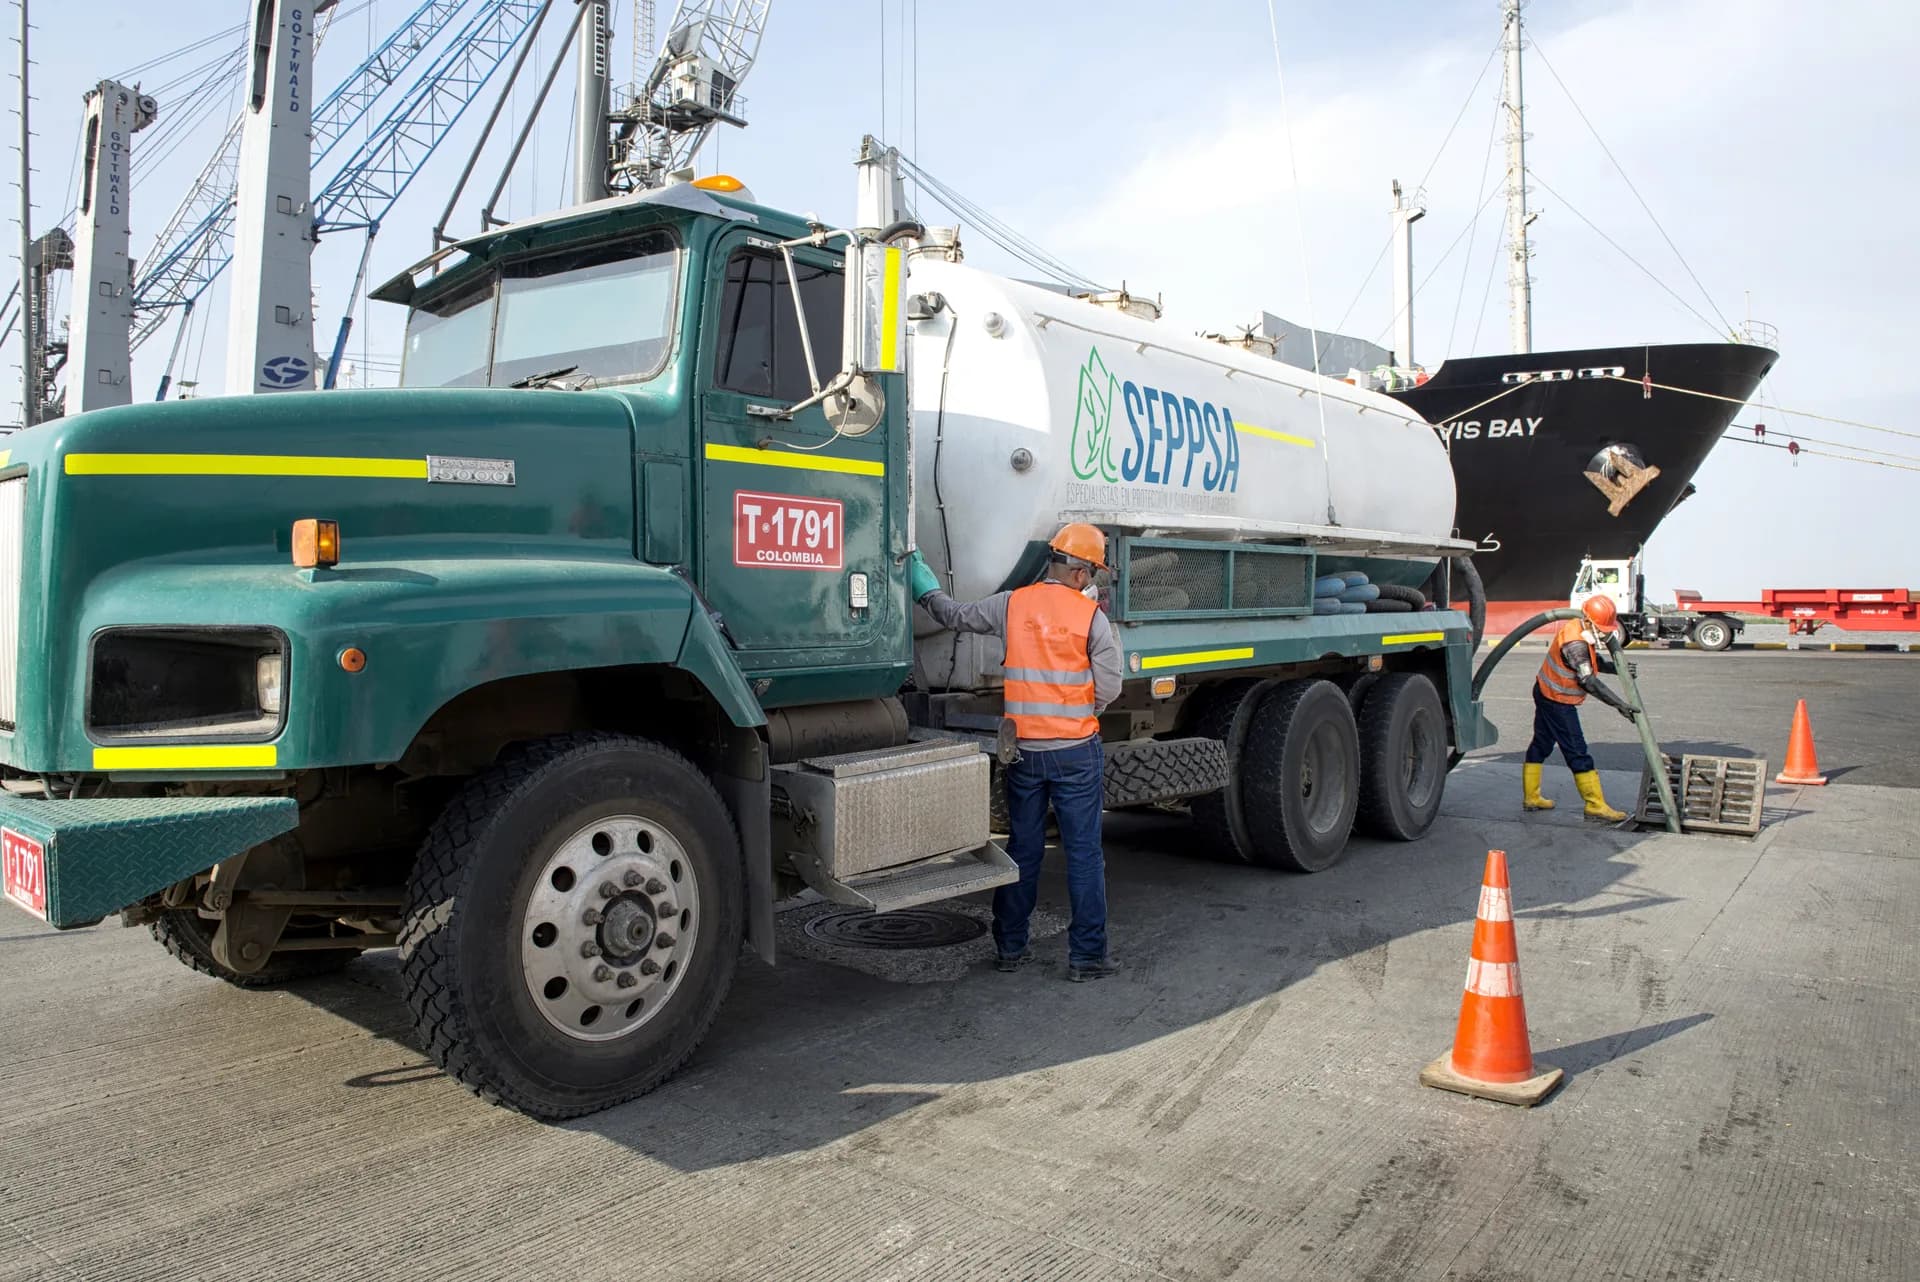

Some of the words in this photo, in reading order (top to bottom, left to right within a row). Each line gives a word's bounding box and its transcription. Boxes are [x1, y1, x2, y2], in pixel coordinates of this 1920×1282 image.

[289, 9, 302, 112] GOTTWALD
[595, 6, 604, 75] LIEBHERR
[110, 131, 121, 215] GOTTWALD
[1121, 380, 1240, 493] SEPPSA
[1488, 417, 1543, 438] BAY
[1066, 482, 1118, 505] ESPECIALISTAS
[1121, 487, 1130, 507] EN
[756, 550, 824, 564] COLOMBIA
